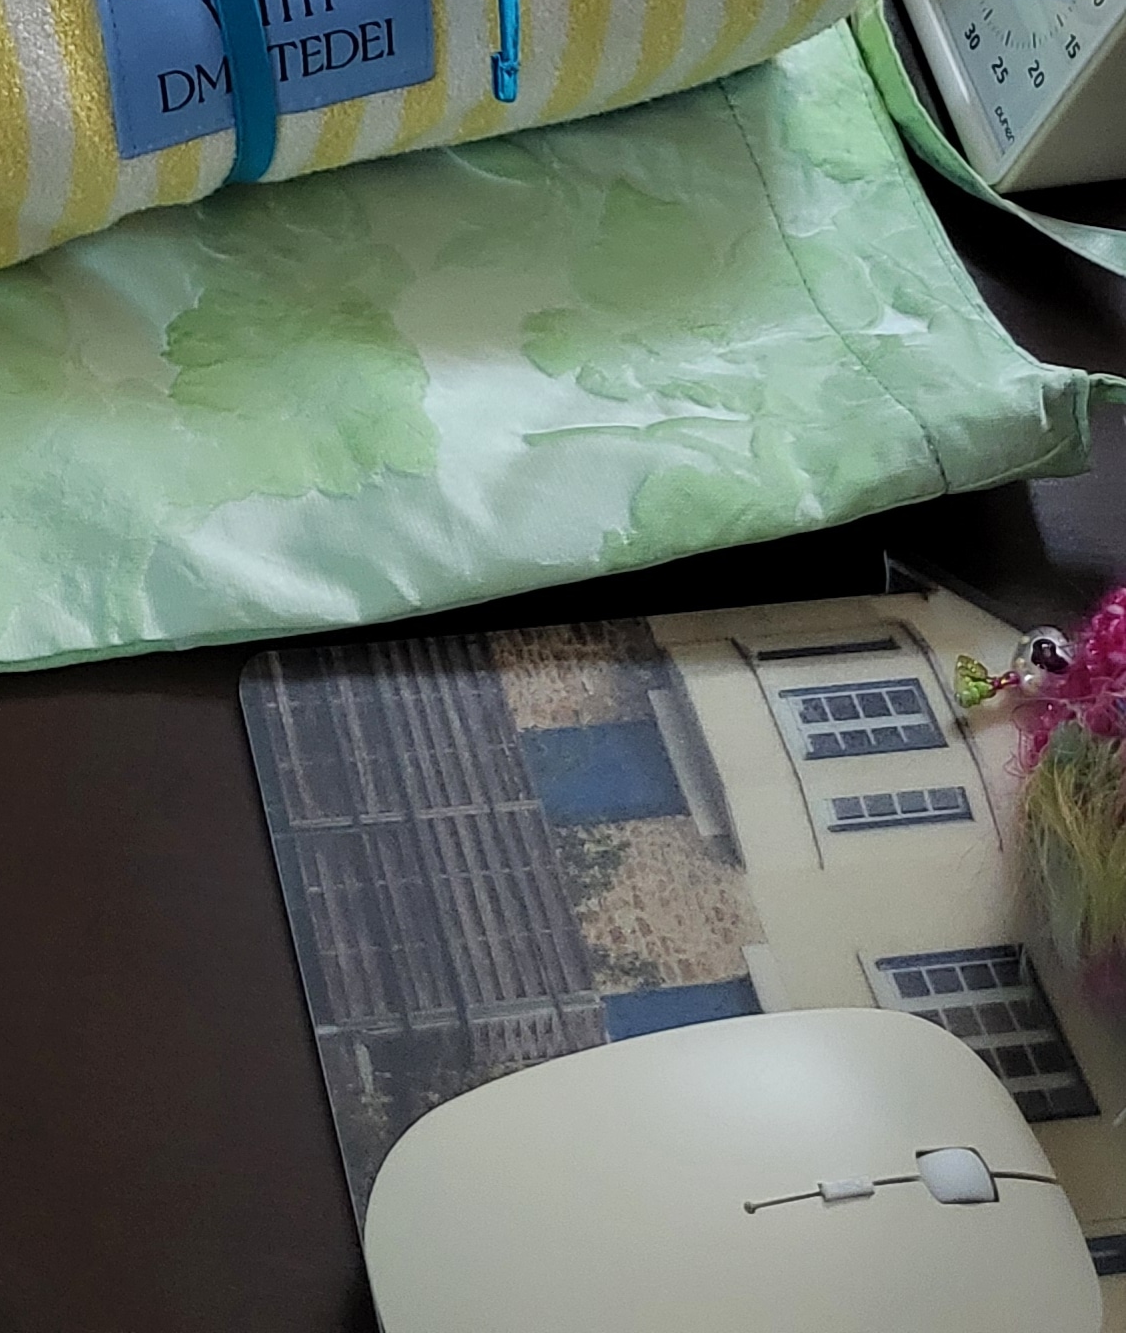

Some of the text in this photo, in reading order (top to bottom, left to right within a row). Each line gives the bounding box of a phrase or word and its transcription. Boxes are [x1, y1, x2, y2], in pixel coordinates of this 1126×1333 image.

[964, 22, 981, 50] 30
[1065, 33, 1081, 59] 15
[157, 17, 396, 114] DMTEDEI
[991, 56, 1009, 84] 25
[1027, 59, 1045, 89] 20
